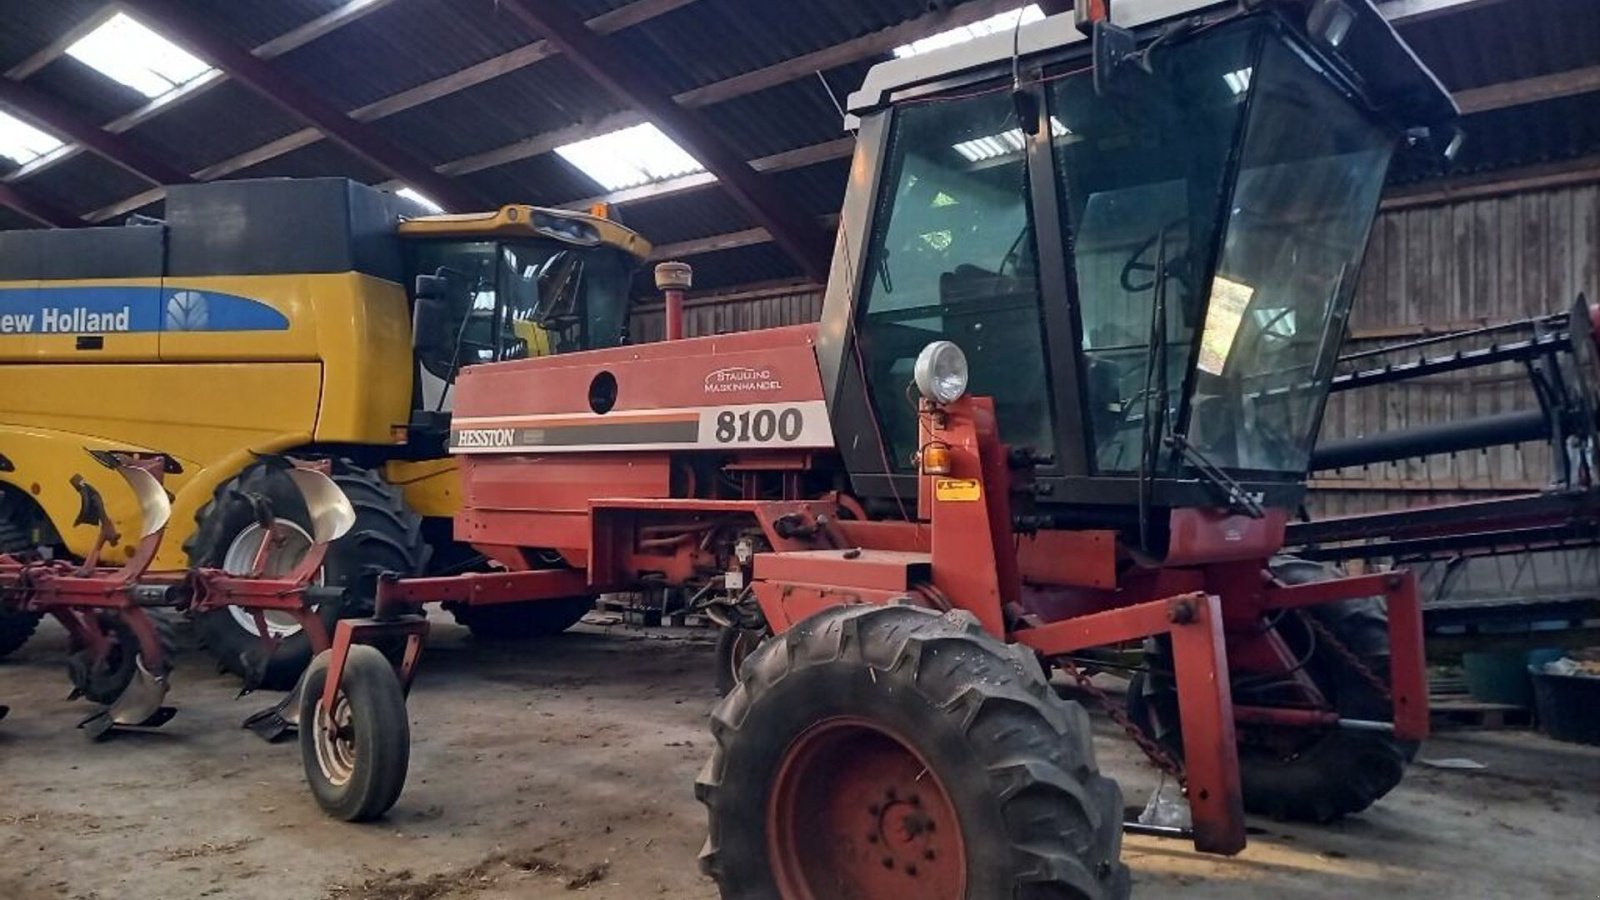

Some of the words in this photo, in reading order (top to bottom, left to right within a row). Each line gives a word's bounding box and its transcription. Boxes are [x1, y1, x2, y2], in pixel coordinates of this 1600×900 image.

[0, 314, 34, 332] ew
[41, 306, 130, 332] Holland
[704, 381, 782, 393] MASKINHANDEL
[715, 407, 804, 443] 8100
[458, 428, 515, 447] HESSTON
